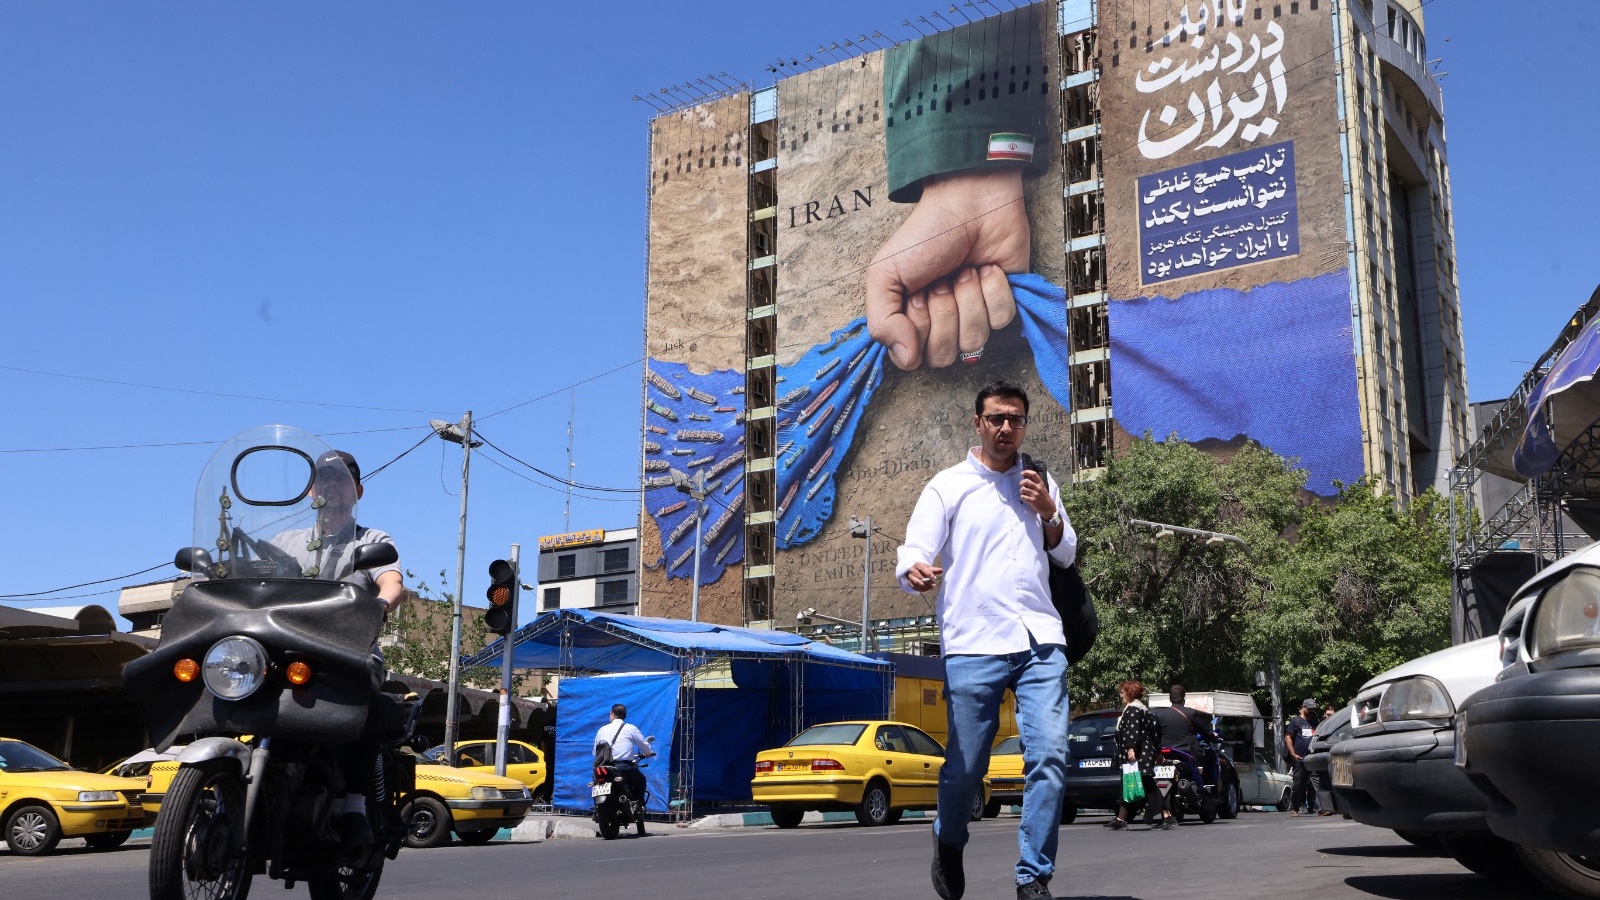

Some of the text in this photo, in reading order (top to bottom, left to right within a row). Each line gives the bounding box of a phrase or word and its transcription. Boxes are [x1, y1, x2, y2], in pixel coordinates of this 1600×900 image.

[1135, 20, 1285, 94] در دست
[1137, 53, 1288, 160] ایران
[1143, 147, 1286, 204] ترامپ هیچ غلطی
[788, 185, 874, 229] IRAN
[1145, 176, 1287, 229] نتوانست بکند
[1147, 210, 1290, 256] کنترل همیشگی تنگه هرمز
[1147, 230, 1290, 278] با ایران خواهد بود
[663, 338, 685, 354] Jask
[800, 544, 864, 567] UNITED
[814, 558, 898, 583] EMIRATES
